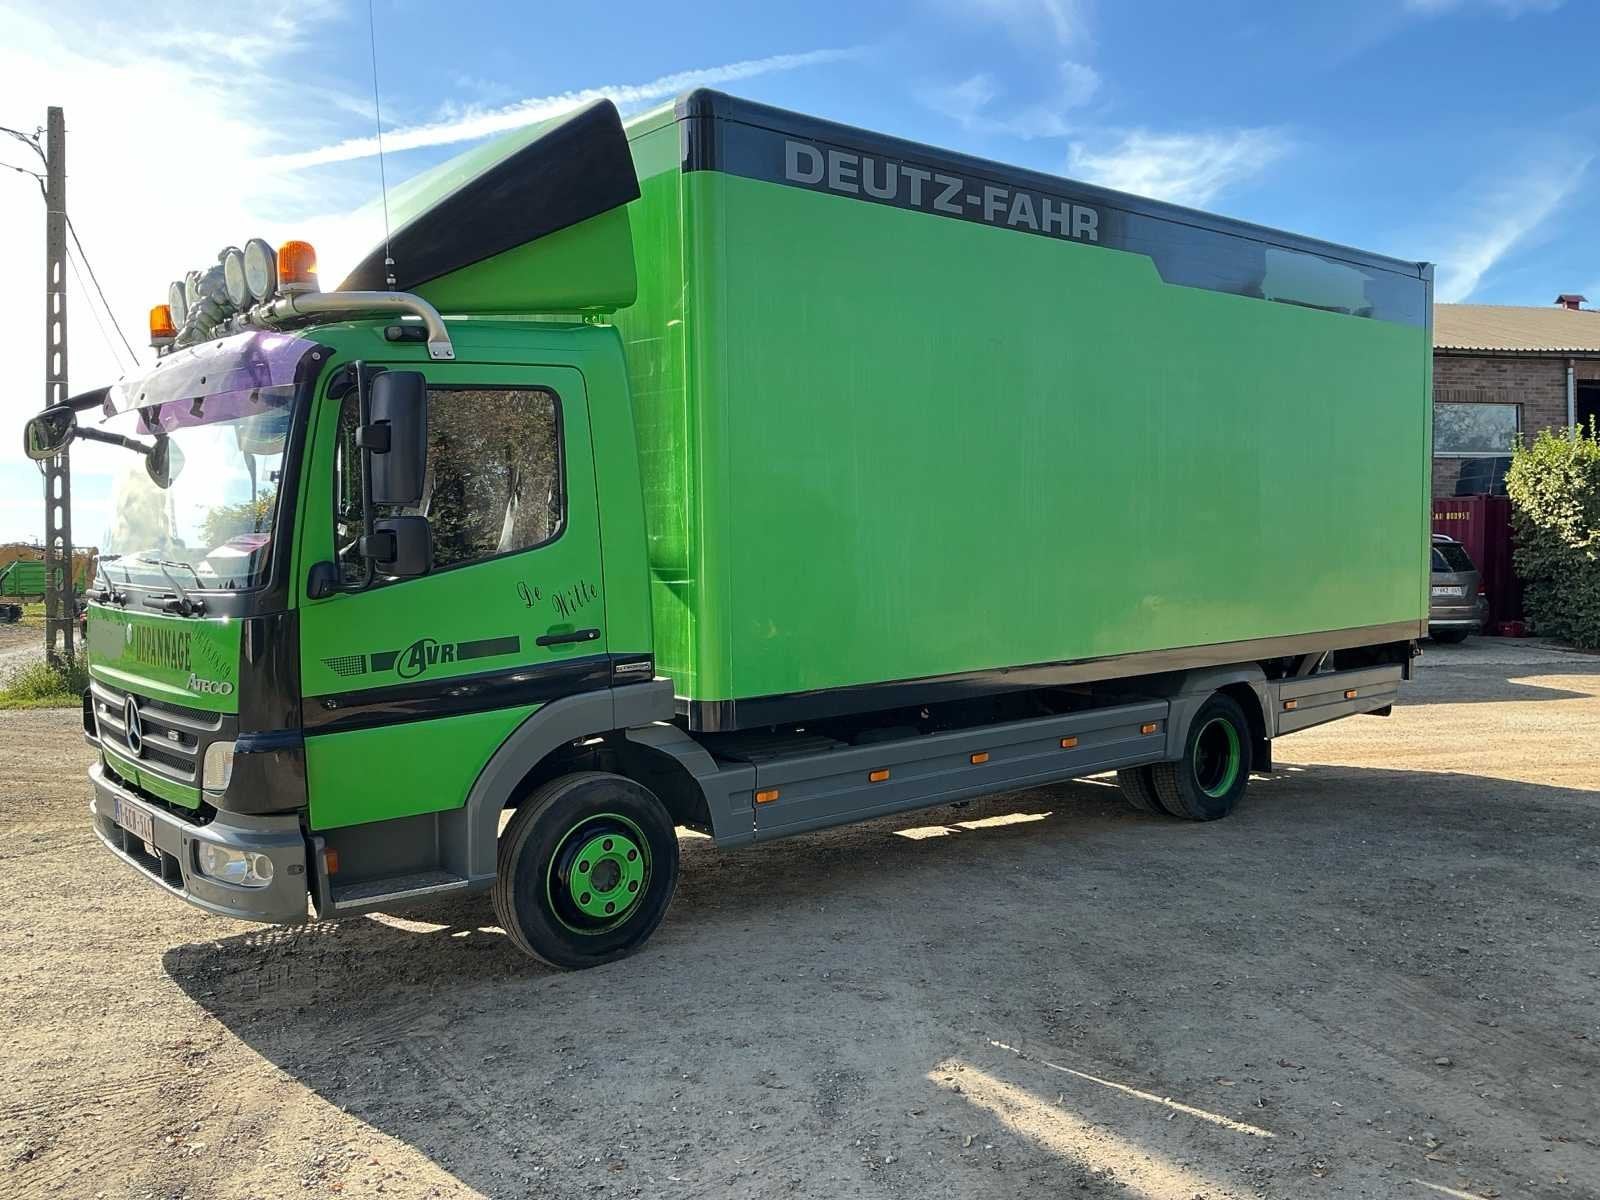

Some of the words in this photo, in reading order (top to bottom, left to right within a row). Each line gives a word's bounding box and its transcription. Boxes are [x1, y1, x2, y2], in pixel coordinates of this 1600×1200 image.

[785, 139, 1099, 242] DEUTZ-FAHR
[517, 580, 541, 608] De
[136, 624, 192, 672] DEPANNAGE
[397, 639, 454, 679] AVR
